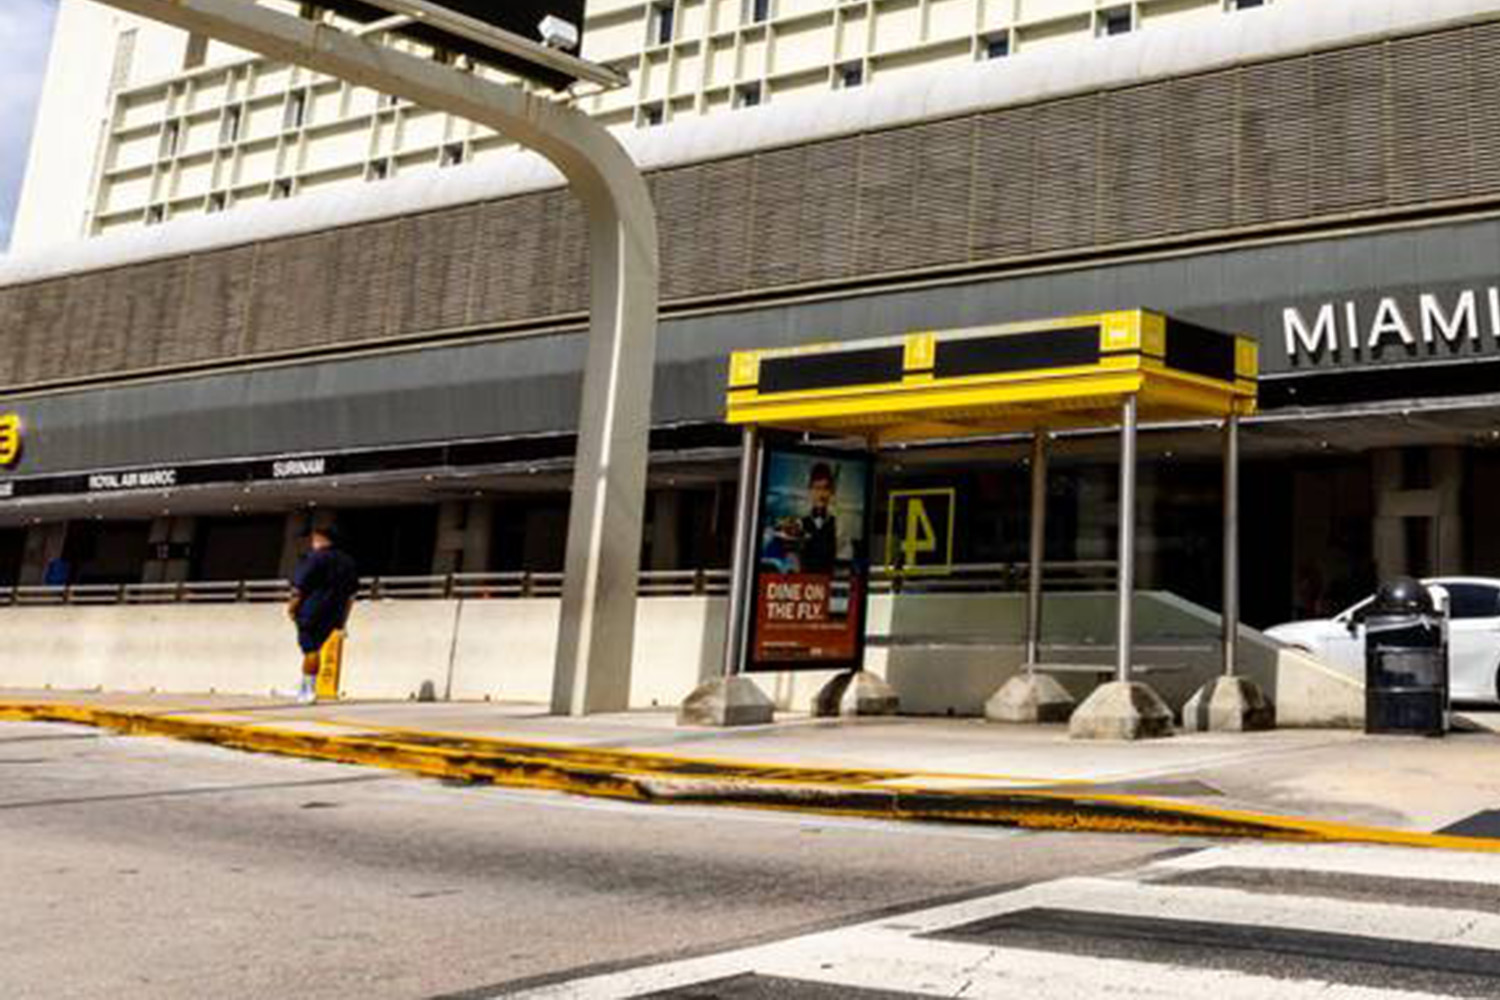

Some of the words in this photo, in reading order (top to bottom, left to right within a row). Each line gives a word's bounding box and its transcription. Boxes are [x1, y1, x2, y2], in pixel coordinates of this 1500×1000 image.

[273, 457, 325, 478] SURINAM
[88, 474, 120, 489] ROYAL
[121, 472, 138, 487] AIR
[139, 469, 177, 486] MAROC
[767, 582, 802, 601] DINE
[804, 582, 826, 601] ON
[767, 601, 796, 620] THE
